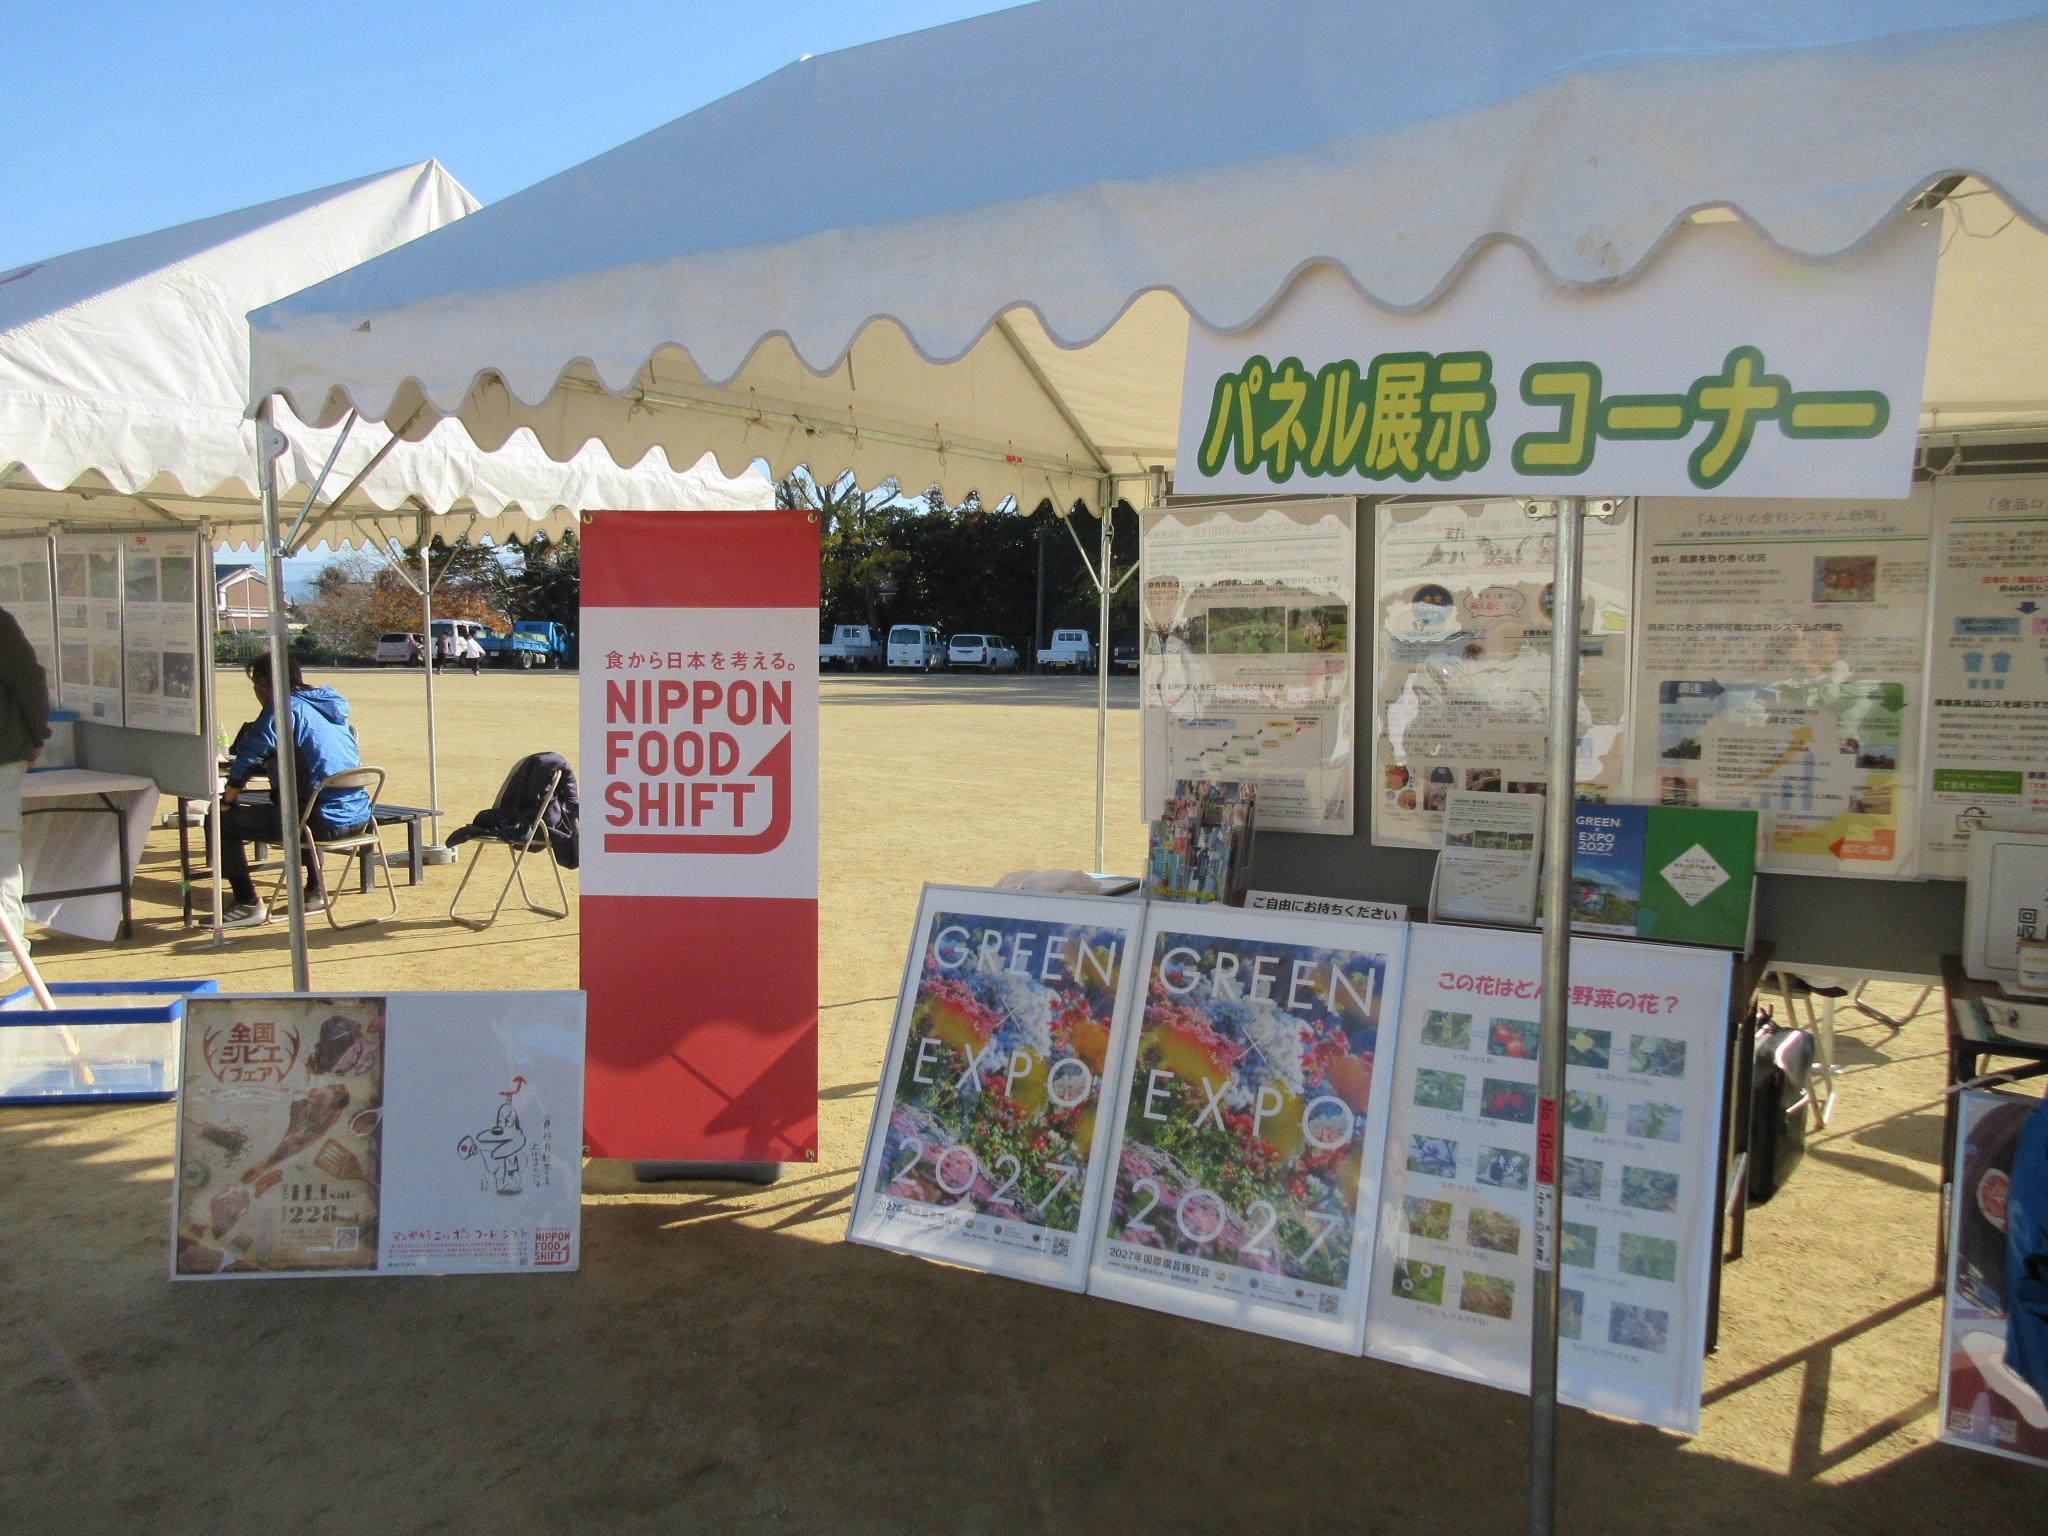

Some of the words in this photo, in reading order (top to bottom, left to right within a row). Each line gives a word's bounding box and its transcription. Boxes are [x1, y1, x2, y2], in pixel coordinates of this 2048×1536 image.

[1989, 497, 2048, 511] 「食品ロ
[605, 650, 796, 671] 食から日本を考える。
[606, 679, 792, 725] NIPPON
[606, 730, 740, 776] FOOD
[604, 781, 756, 827] SHIFT
[1576, 816, 1621, 828] GREEN
[1577, 841, 1614, 852] 2027
[1578, 832, 1615, 843] EXPO
[1253, 896, 1398, 922] ご自由にお持ちください
[934, 926, 1117, 986] GREEN
[1159, 947, 1376, 1017] GREEN
[227, 1022, 276, 1043] 全国
[219, 1044, 284, 1064] ジビエ
[229, 1067, 274, 1082] フェア
[912, 1038, 1092, 1107] EXPO
[1143, 1069, 1354, 1149] EXPO
[891, 1137, 1078, 1211] 2027
[1125, 1178, 1344, 1265] 2027
[535, 1232, 571, 1242] NIPPON
[535, 1242, 561, 1251] FOOD
[534, 1251, 564, 1261] SHIFT
[1109, 1246, 1210, 1279] 2027年国際園芸博覧会
